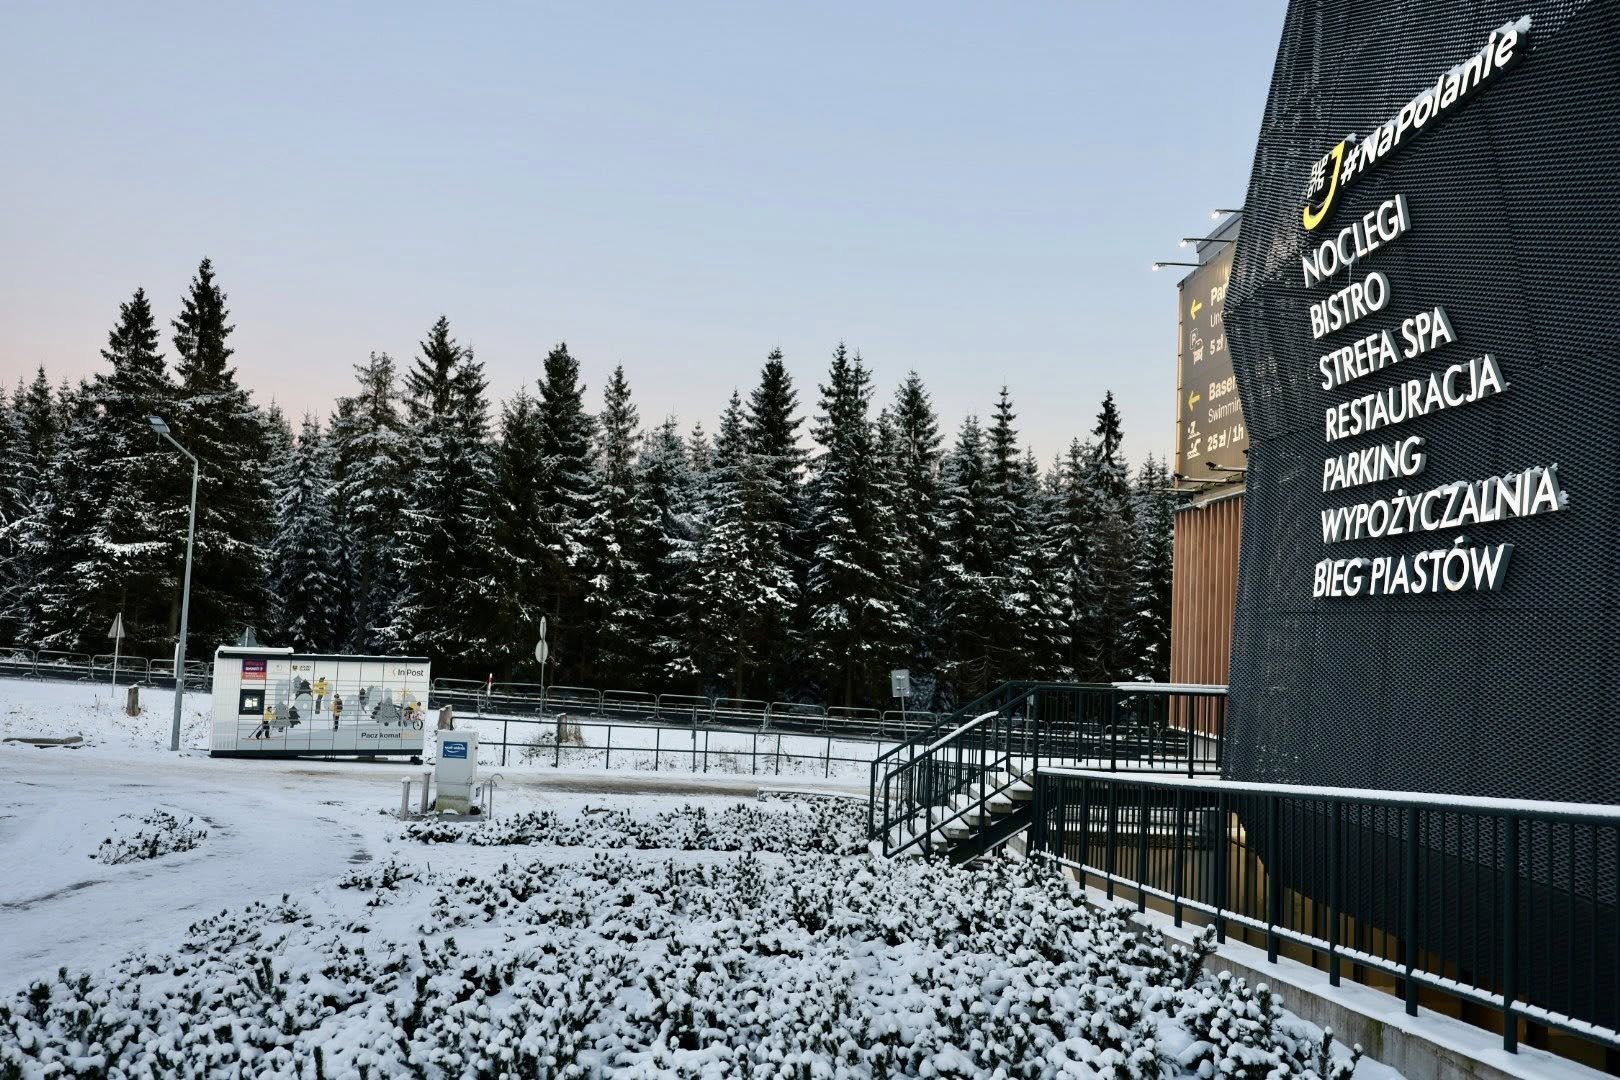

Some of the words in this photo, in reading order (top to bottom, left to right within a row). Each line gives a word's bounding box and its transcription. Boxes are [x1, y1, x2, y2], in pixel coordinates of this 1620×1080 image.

[1341, 29, 1518, 186] #NaPolanie
[1302, 194, 1407, 288] NOCLEGI
[1210, 276, 1229, 307] Par
[1310, 272, 1387, 340] BISTRO
[1209, 339, 1216, 356] 5
[1319, 329, 1400, 391] STREFA
[1401, 306, 1454, 359] SPA
[1208, 396, 1243, 424] Swimmin
[1325, 354, 1503, 442] RESTAURACJA
[1207, 432, 1218, 453] 25
[1322, 435, 1423, 493] PARKING
[1321, 467, 1560, 544] WYPOŻYCZALNIA
[1313, 559, 1363, 598] BIEG
[1369, 536, 1507, 596] PIASTÓW
